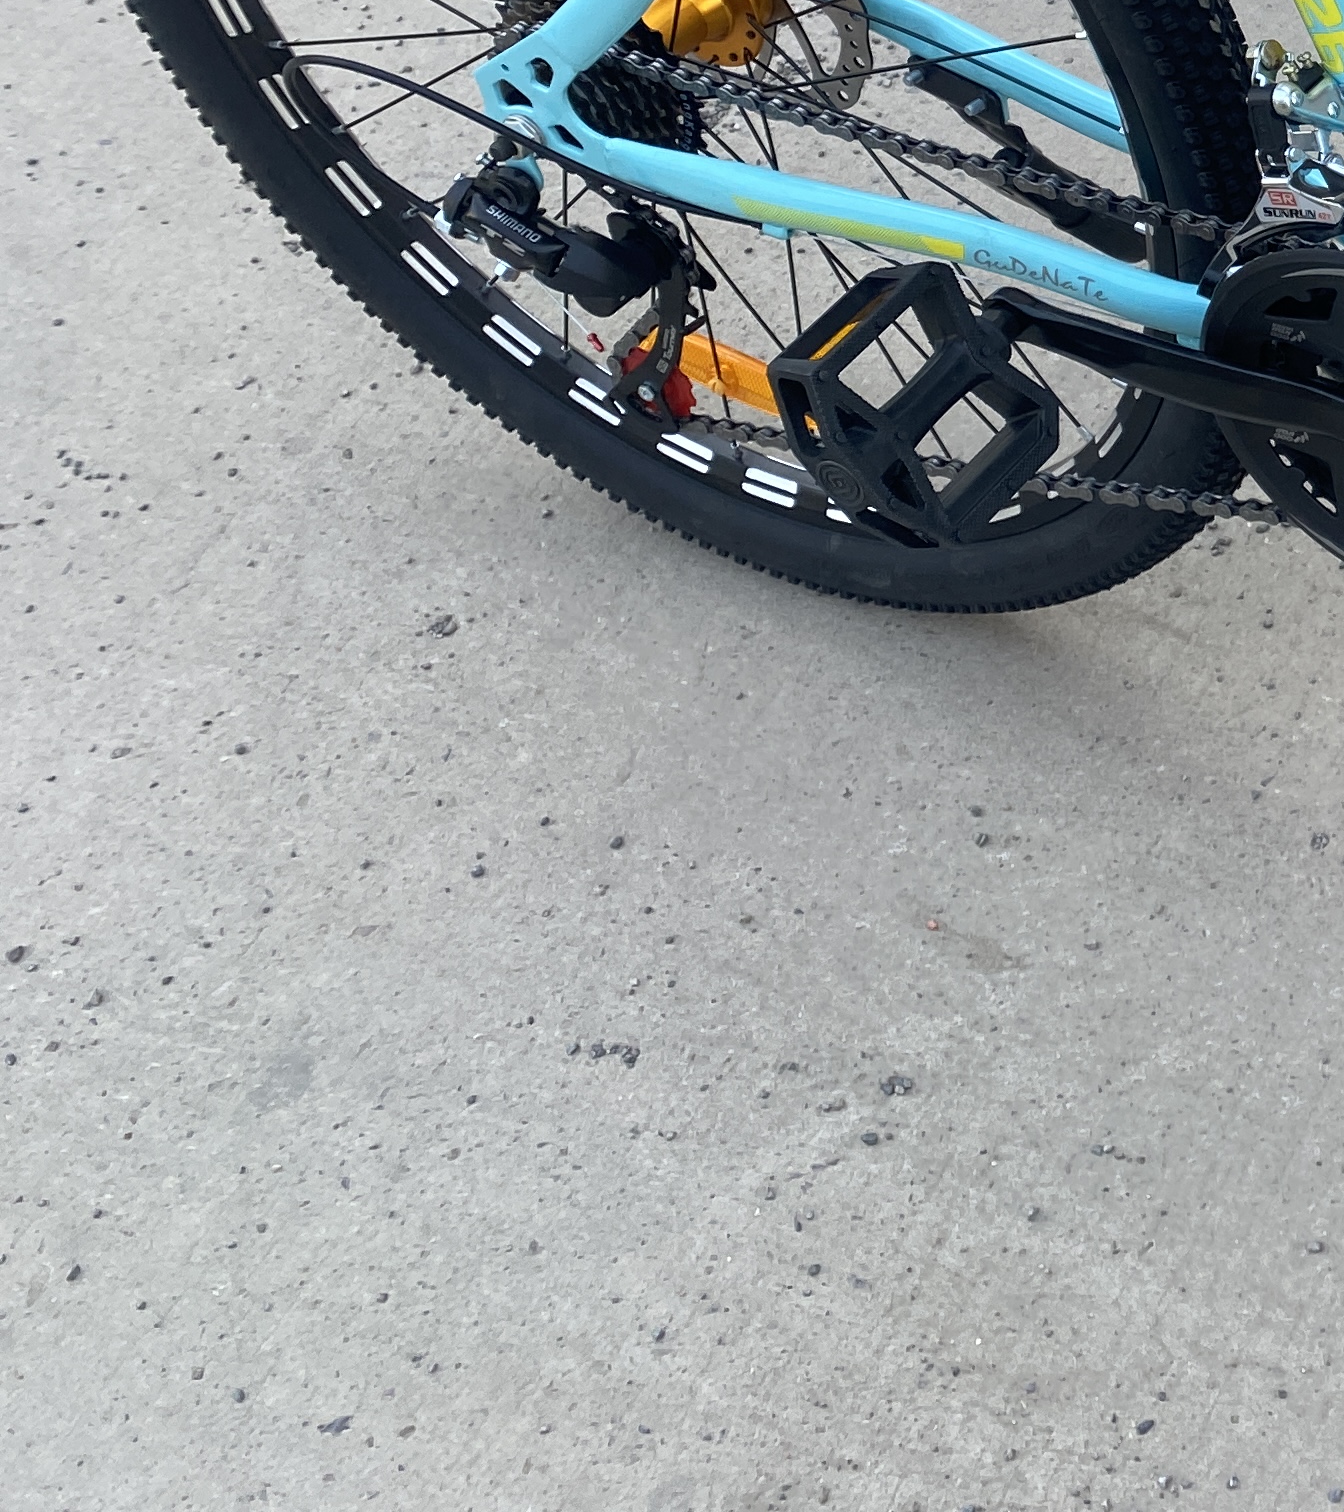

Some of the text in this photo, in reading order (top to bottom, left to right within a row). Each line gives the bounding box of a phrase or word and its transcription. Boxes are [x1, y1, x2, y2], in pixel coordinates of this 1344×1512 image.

[485, 204, 542, 243] SHIMANO
[1262, 206, 1317, 220] SUNRUN
[973, 249, 1109, 302] GuDeNaTe
